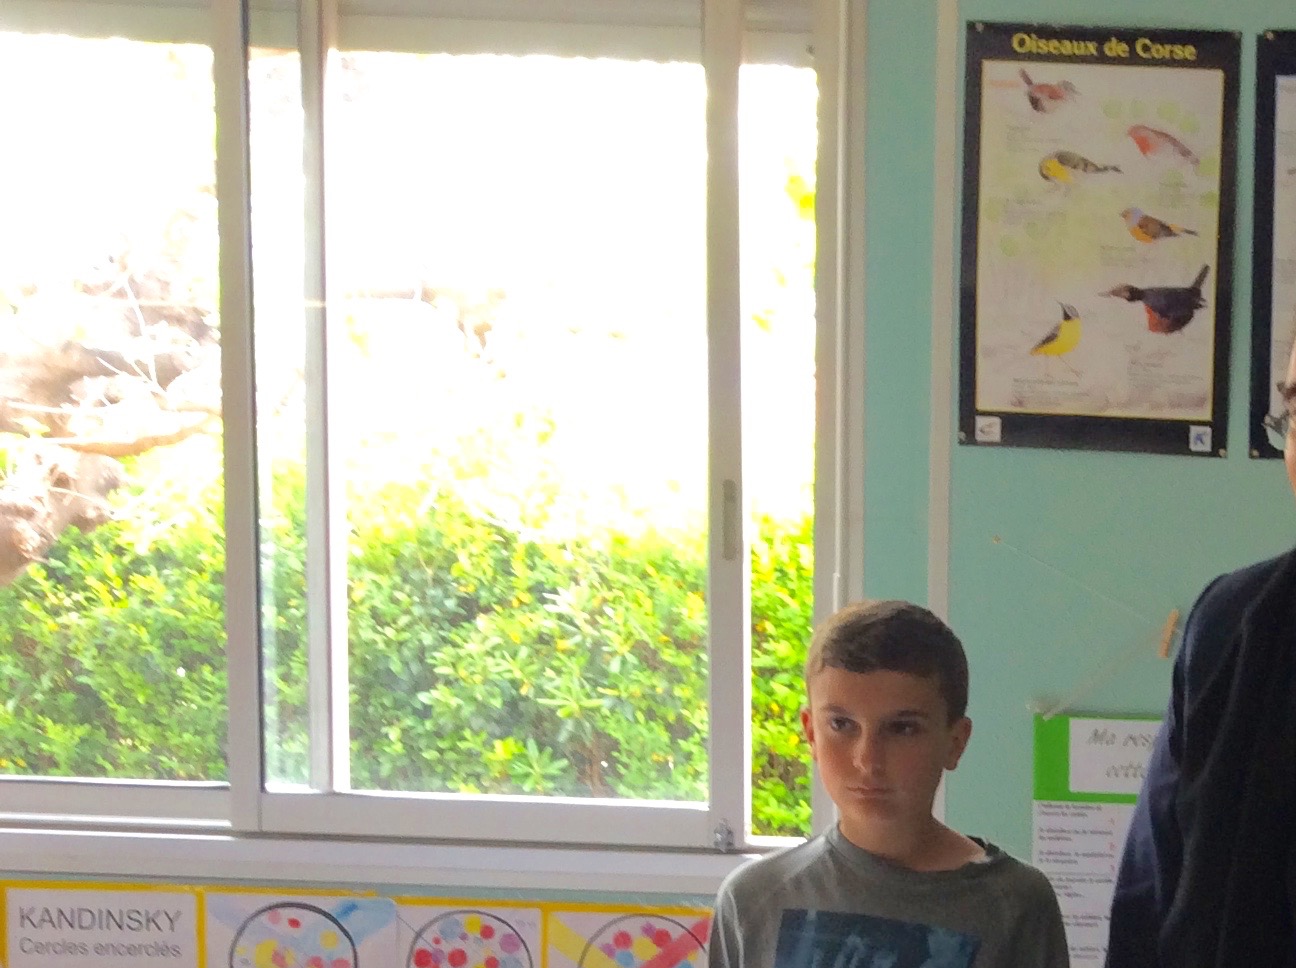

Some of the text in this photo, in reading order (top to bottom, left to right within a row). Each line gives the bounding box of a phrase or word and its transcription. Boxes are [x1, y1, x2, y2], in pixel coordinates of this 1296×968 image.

[1012, 32, 1197, 61] Oiseaux de Corse
[19, 906, 183, 932] KANDINSKY
[19, 937, 183, 958] Cercles encerclés
